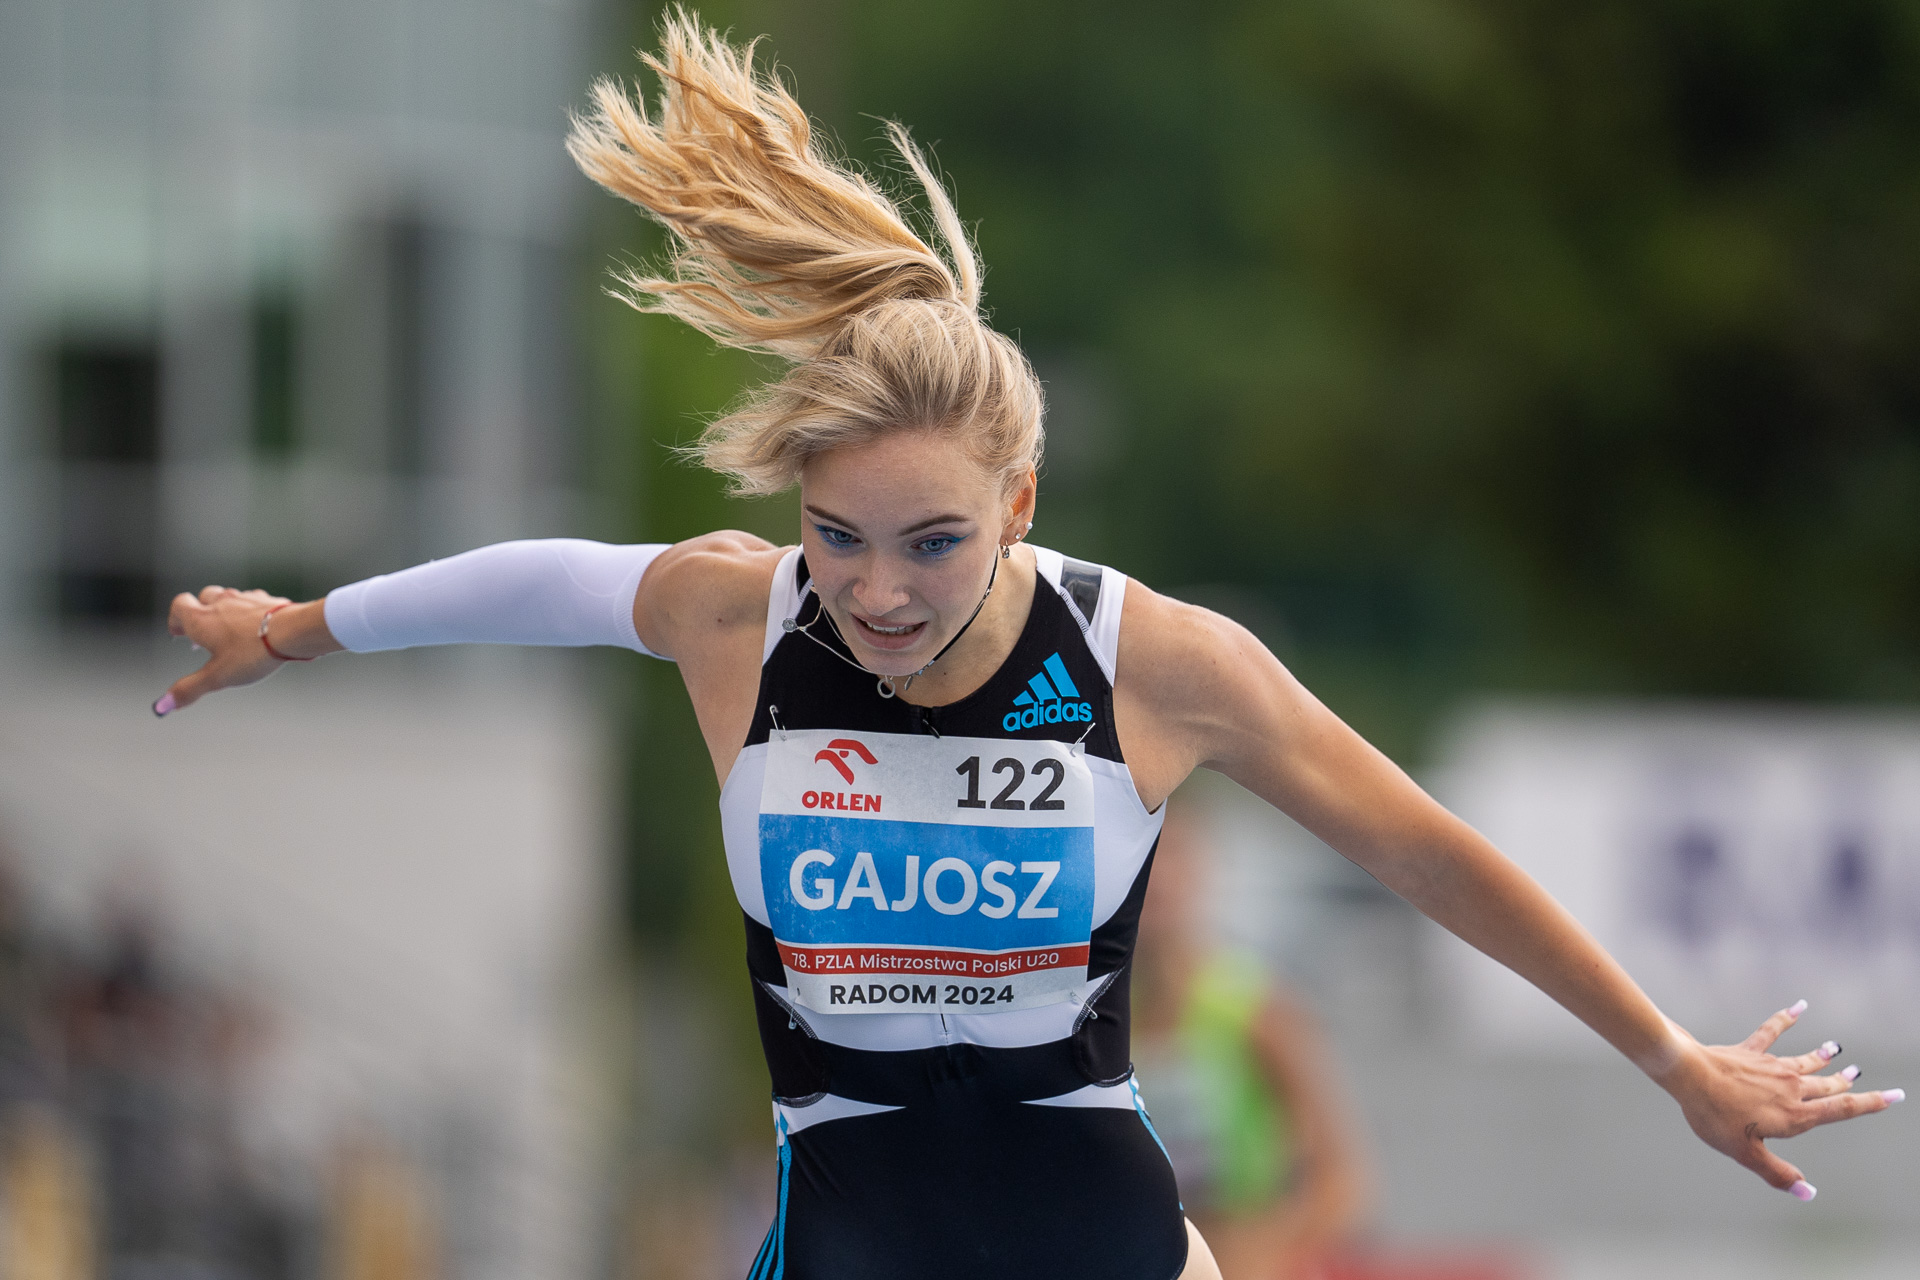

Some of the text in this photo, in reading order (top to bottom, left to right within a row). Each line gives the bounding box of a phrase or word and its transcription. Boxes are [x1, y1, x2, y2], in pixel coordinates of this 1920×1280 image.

[1003, 698, 1092, 732] adidas
[955, 756, 1065, 811] 122
[801, 790, 882, 813] ORLEN
[789, 849, 1061, 919] GAJOSZ
[791, 952, 1059, 973] 78. PZLA Mistrzostwa Polski U20
[830, 984, 1014, 1005] RADOM 2024
